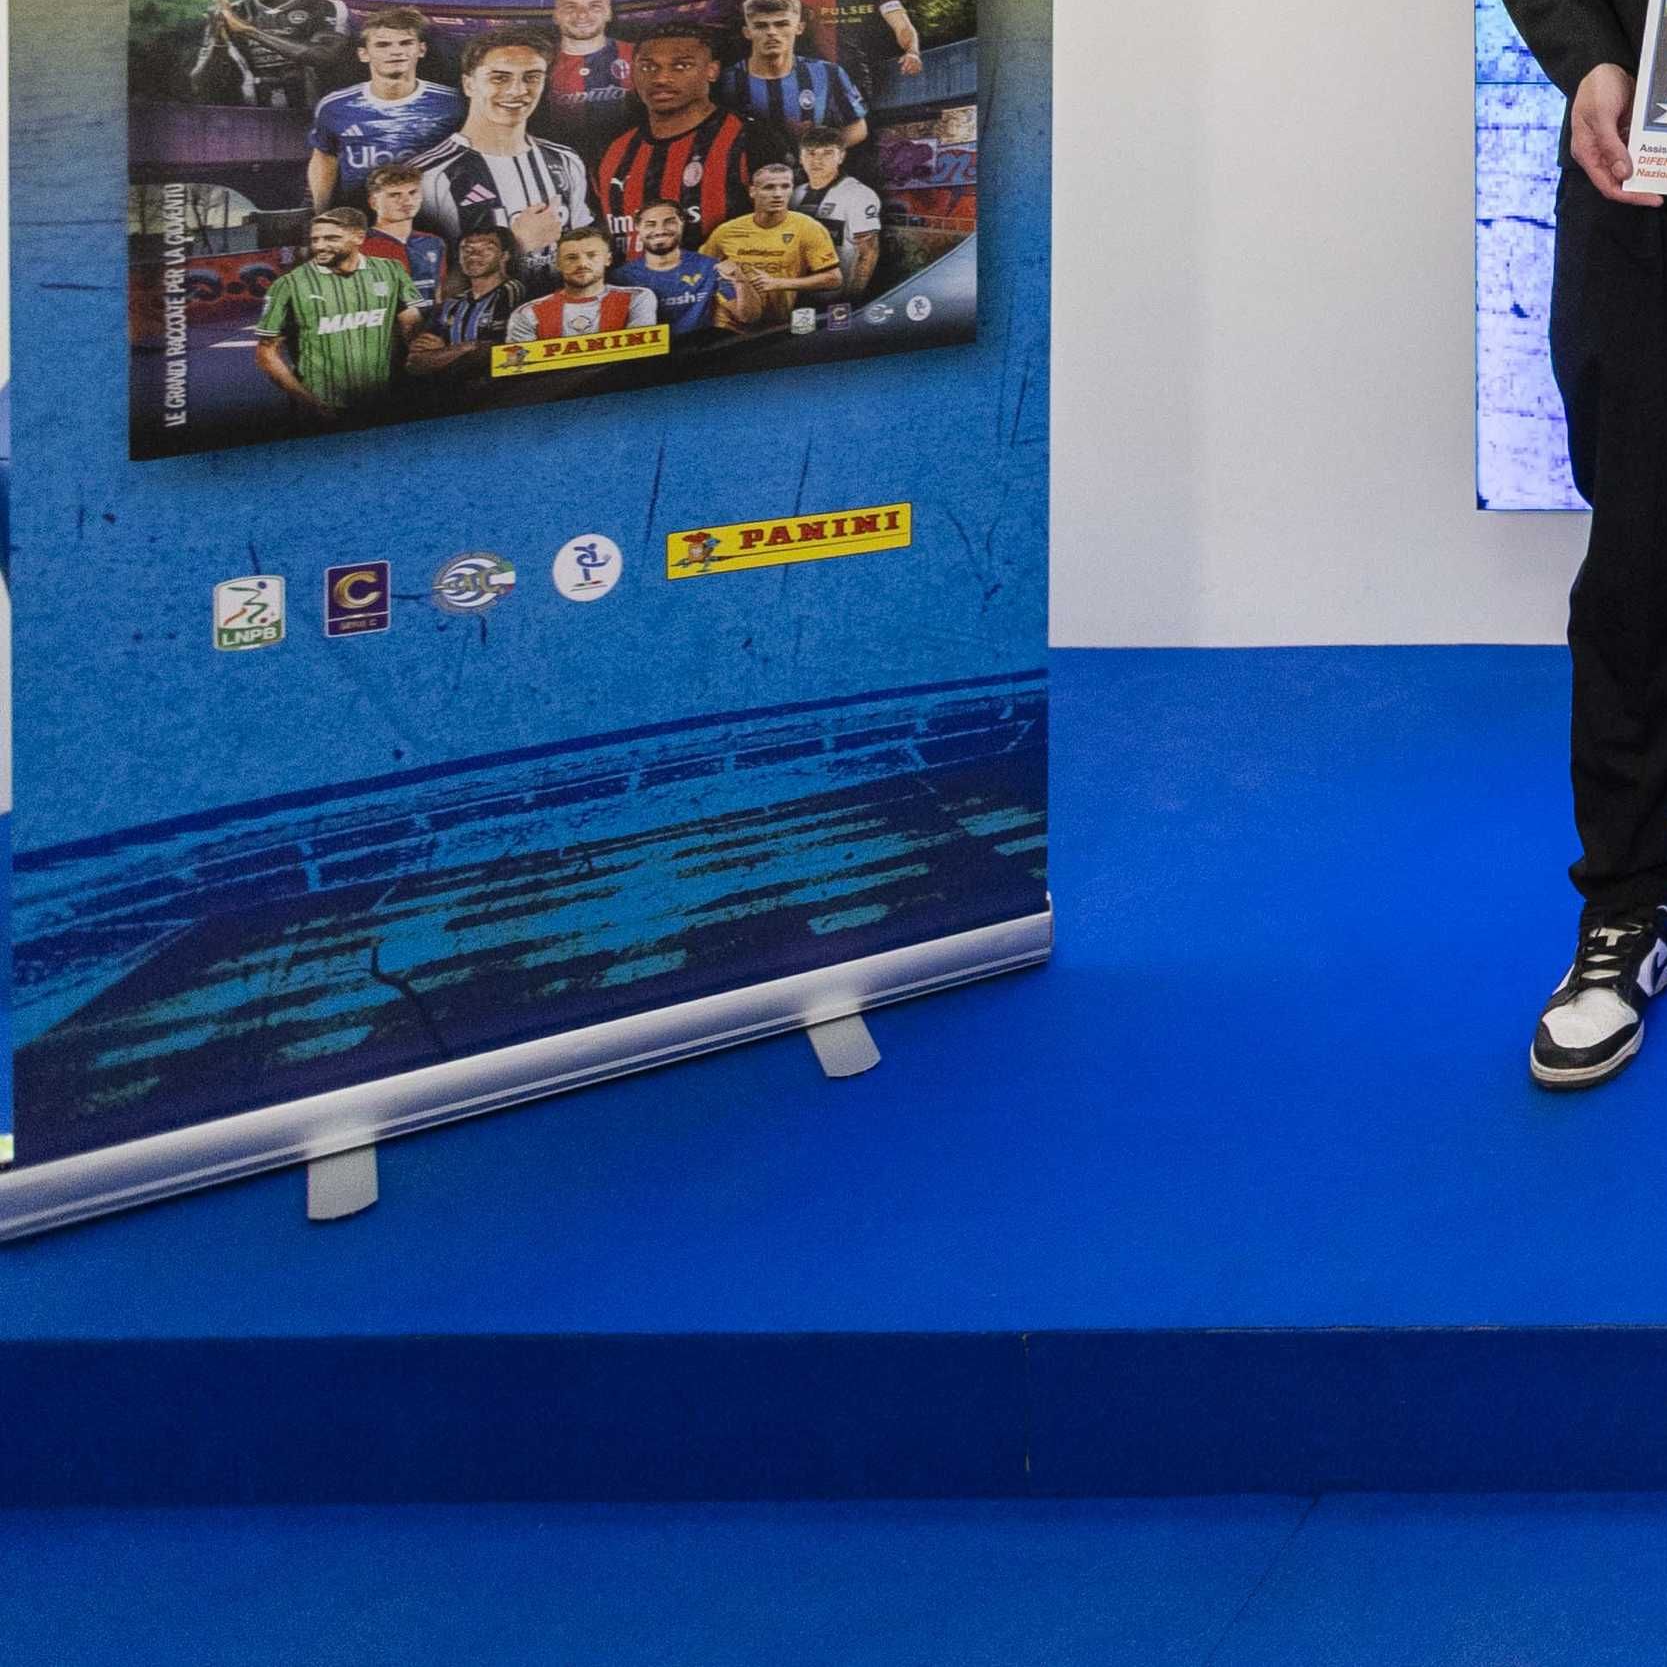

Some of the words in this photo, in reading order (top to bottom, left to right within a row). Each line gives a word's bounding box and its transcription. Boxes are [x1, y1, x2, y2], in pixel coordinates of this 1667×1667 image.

[820, 3, 875, 16] PULSEE
[164, 247, 186, 265] LA
[164, 268, 186, 293] PER
[318, 308, 388, 335] MAPEI
[543, 329, 662, 358] PANINI
[165, 359, 187, 409] GRANDI
[165, 411, 187, 428] LE
[738, 509, 901, 551] PANINI
[221, 625, 278, 648] LNPB
